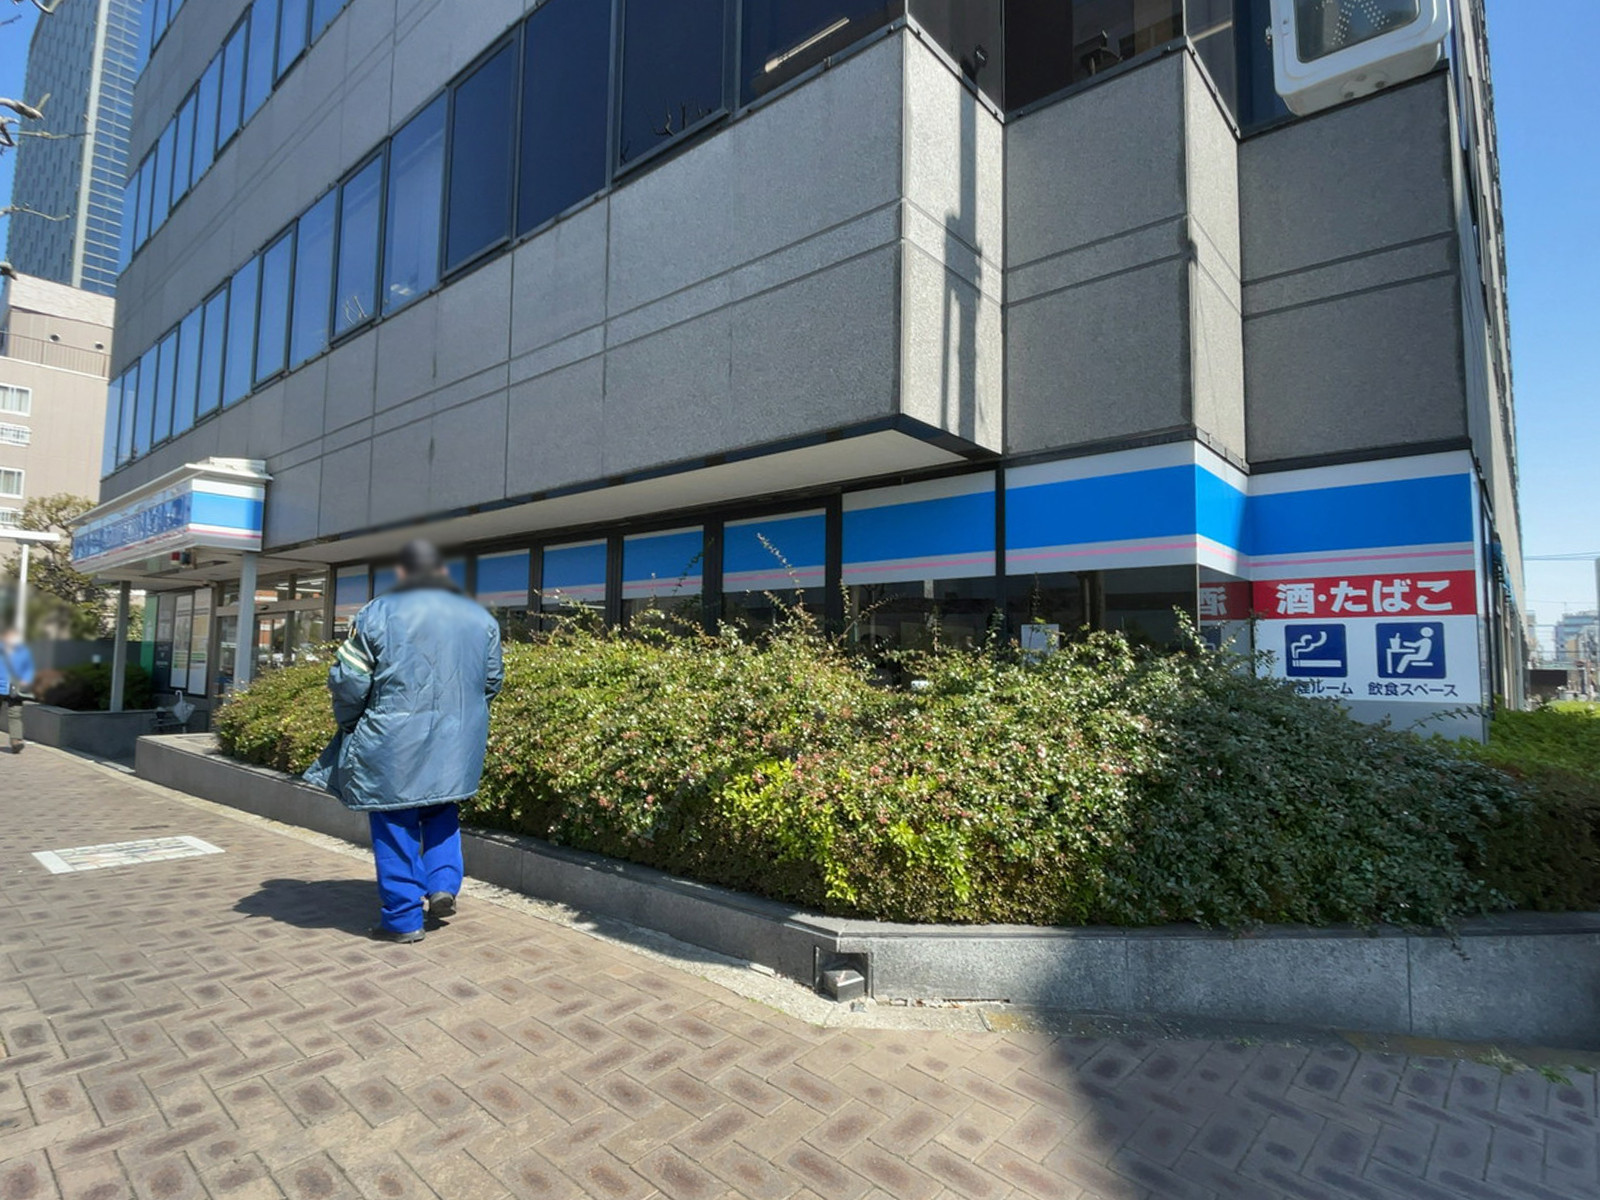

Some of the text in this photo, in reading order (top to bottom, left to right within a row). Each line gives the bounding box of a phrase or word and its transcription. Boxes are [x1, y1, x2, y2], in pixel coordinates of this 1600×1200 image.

[1276, 579, 1453, 614] 酒・たばこ
[1368, 682, 1459, 697] 飲食スペース
